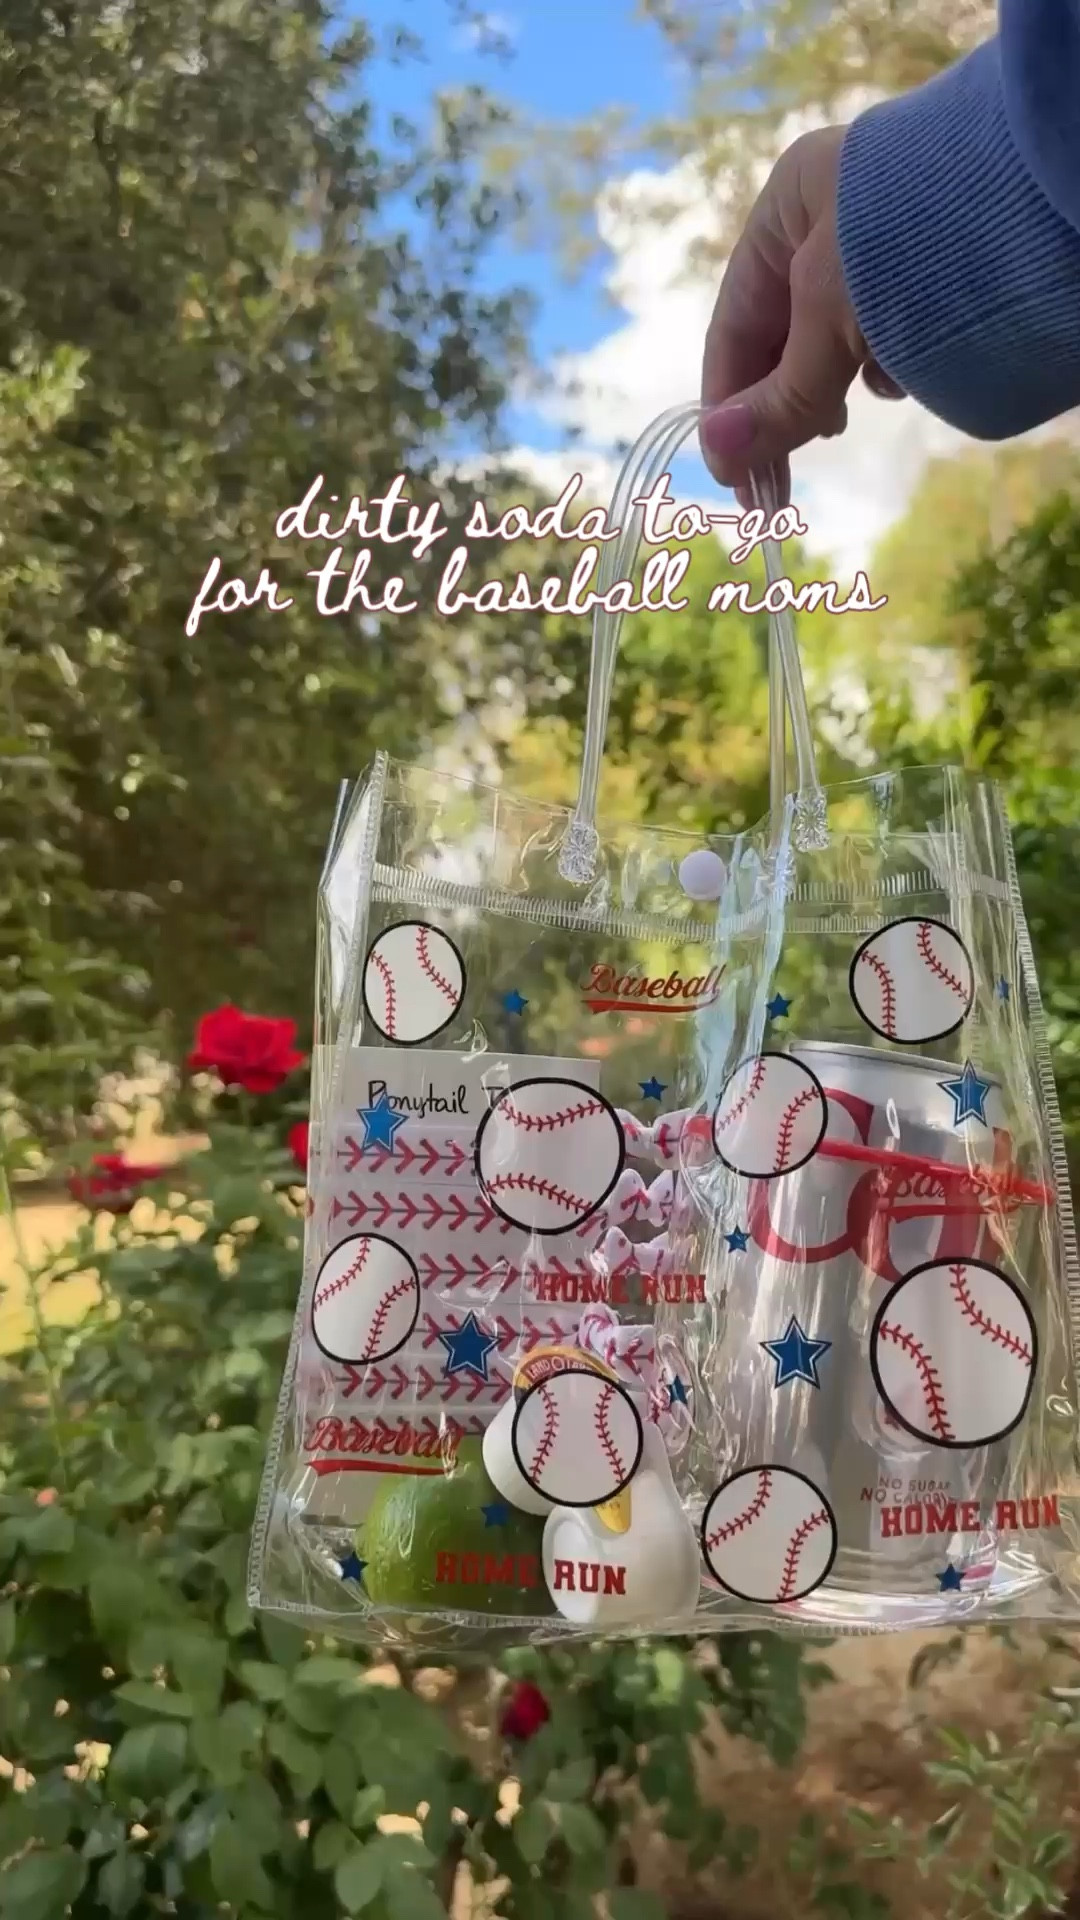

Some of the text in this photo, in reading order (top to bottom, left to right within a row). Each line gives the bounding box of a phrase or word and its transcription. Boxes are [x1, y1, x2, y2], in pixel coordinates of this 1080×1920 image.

[578, 963, 727, 1000] Baseball
[367, 1080, 469, 1119] Ponytail
[536, 1273, 708, 1304] HOME RUN
[525, 1359, 551, 1380] LAND
[303, 1416, 466, 1461] Baseball
[860, 1487, 887, 1503] NO
[879, 1476, 903, 1490] NO
[880, 1494, 1062, 1538] HOME RUN
[435, 1551, 627, 1595] HOME RUN
